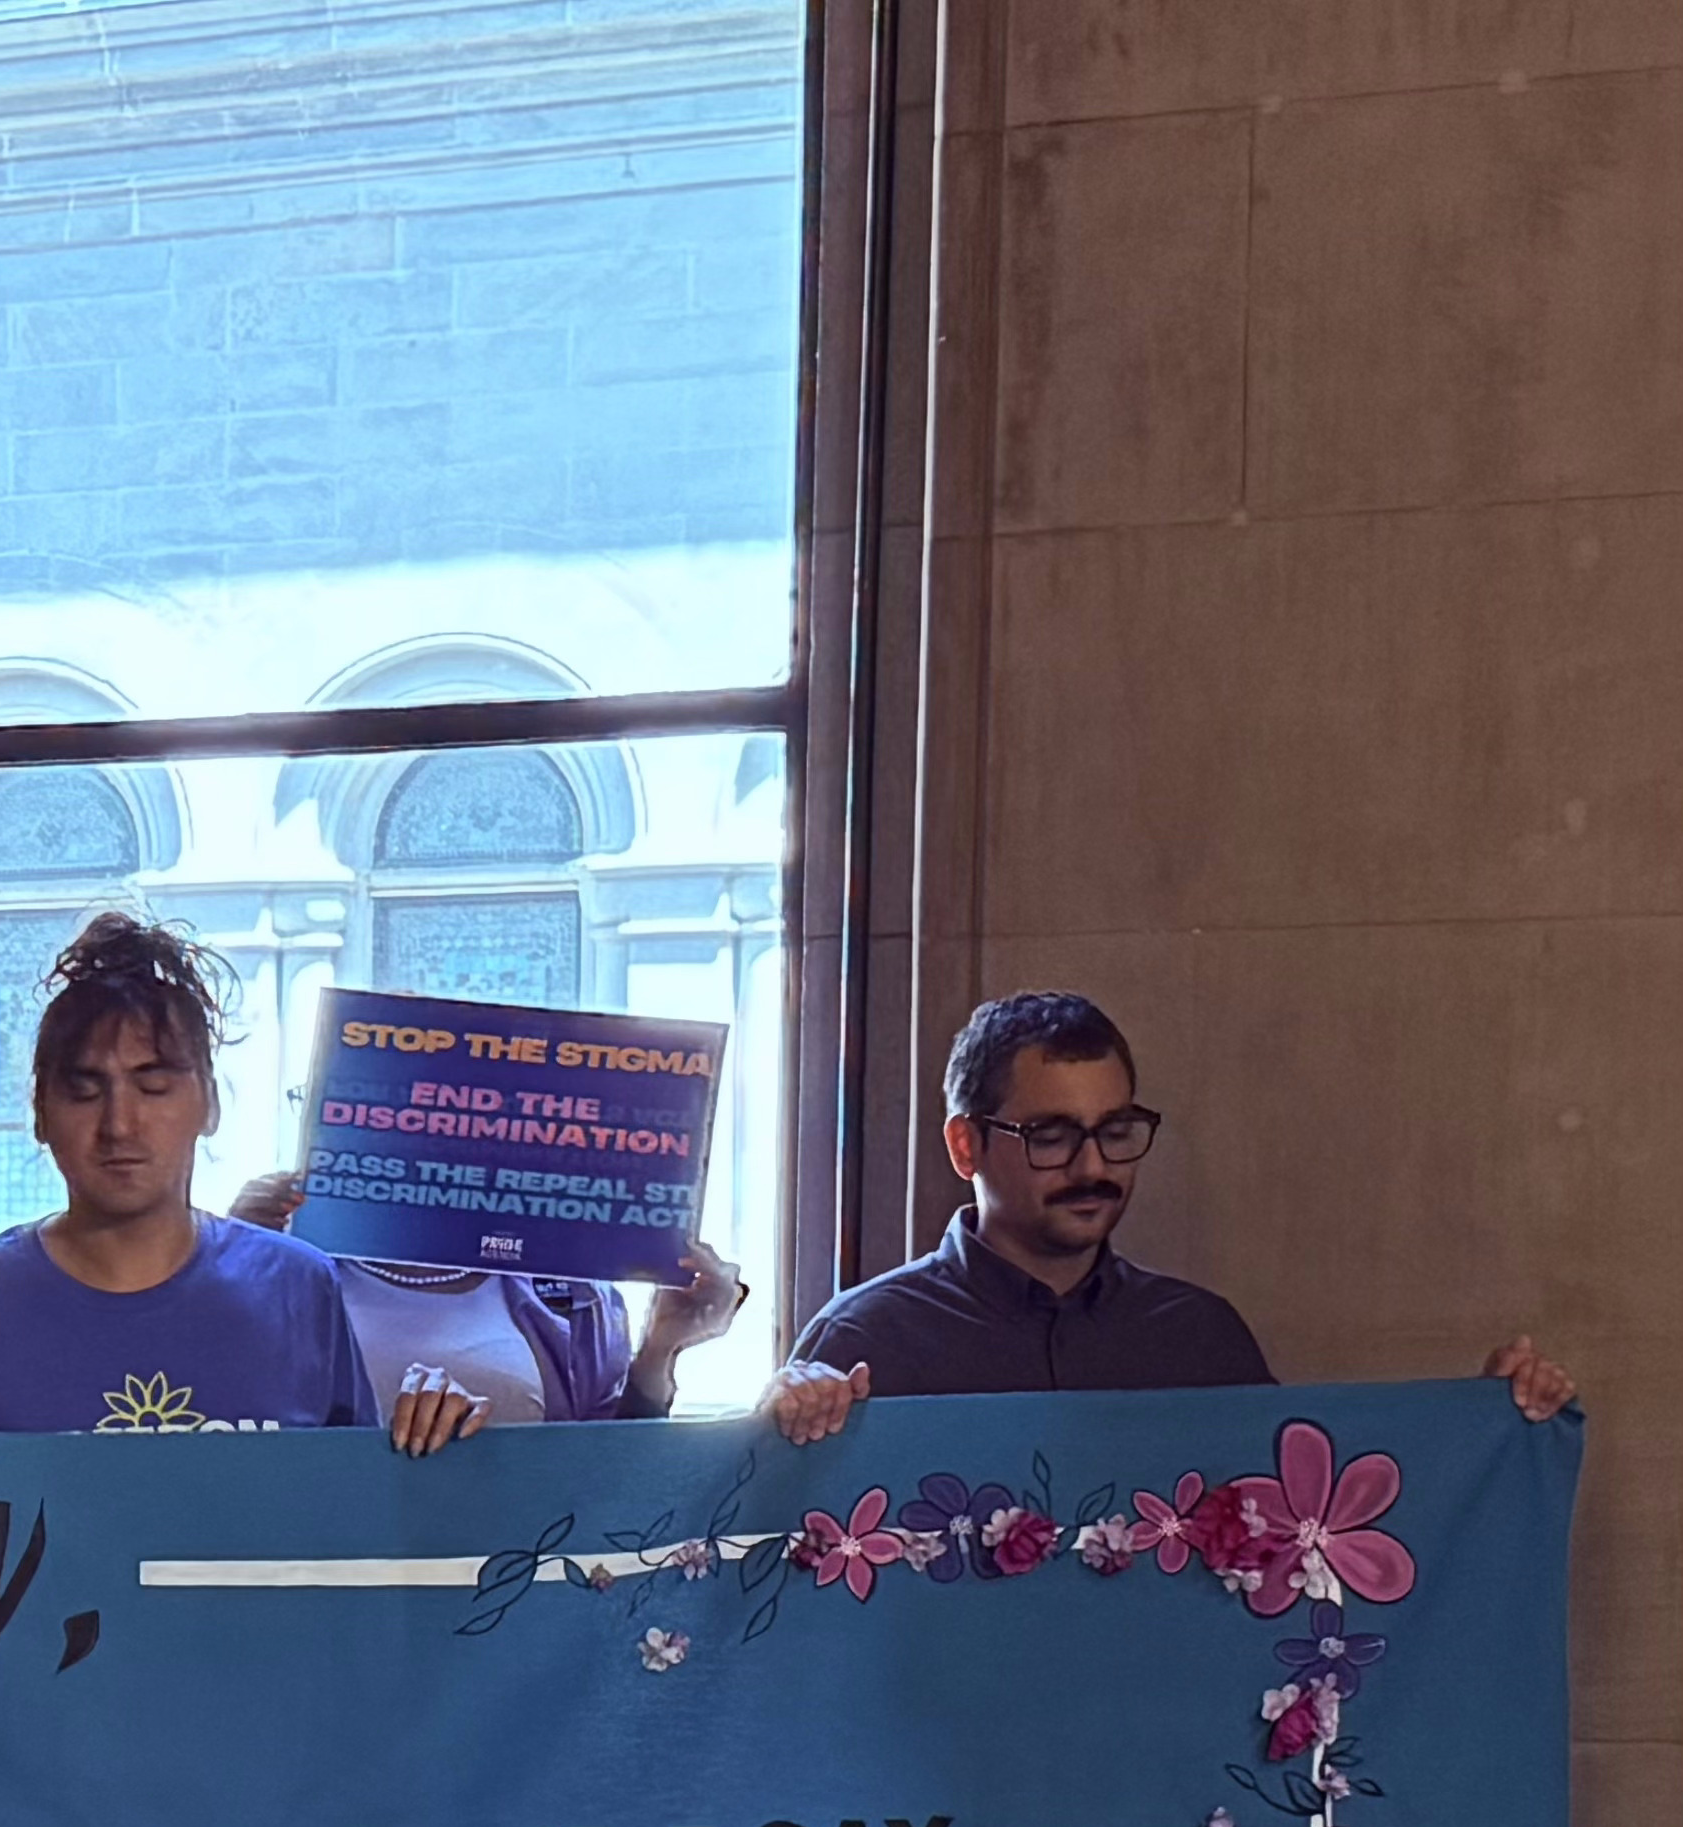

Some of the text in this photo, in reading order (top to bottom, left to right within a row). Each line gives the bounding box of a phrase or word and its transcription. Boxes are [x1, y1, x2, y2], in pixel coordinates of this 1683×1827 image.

[341, 1020, 713, 1077] STOP THE STIGMA
[321, 1100, 690, 1157] DISCRIMINATION
[410, 1081, 600, 1122] END THE
[303, 1174, 696, 1231] DISCRIMINATION ACT
[310, 1150, 698, 1207] PASS THE REPEAL STI
